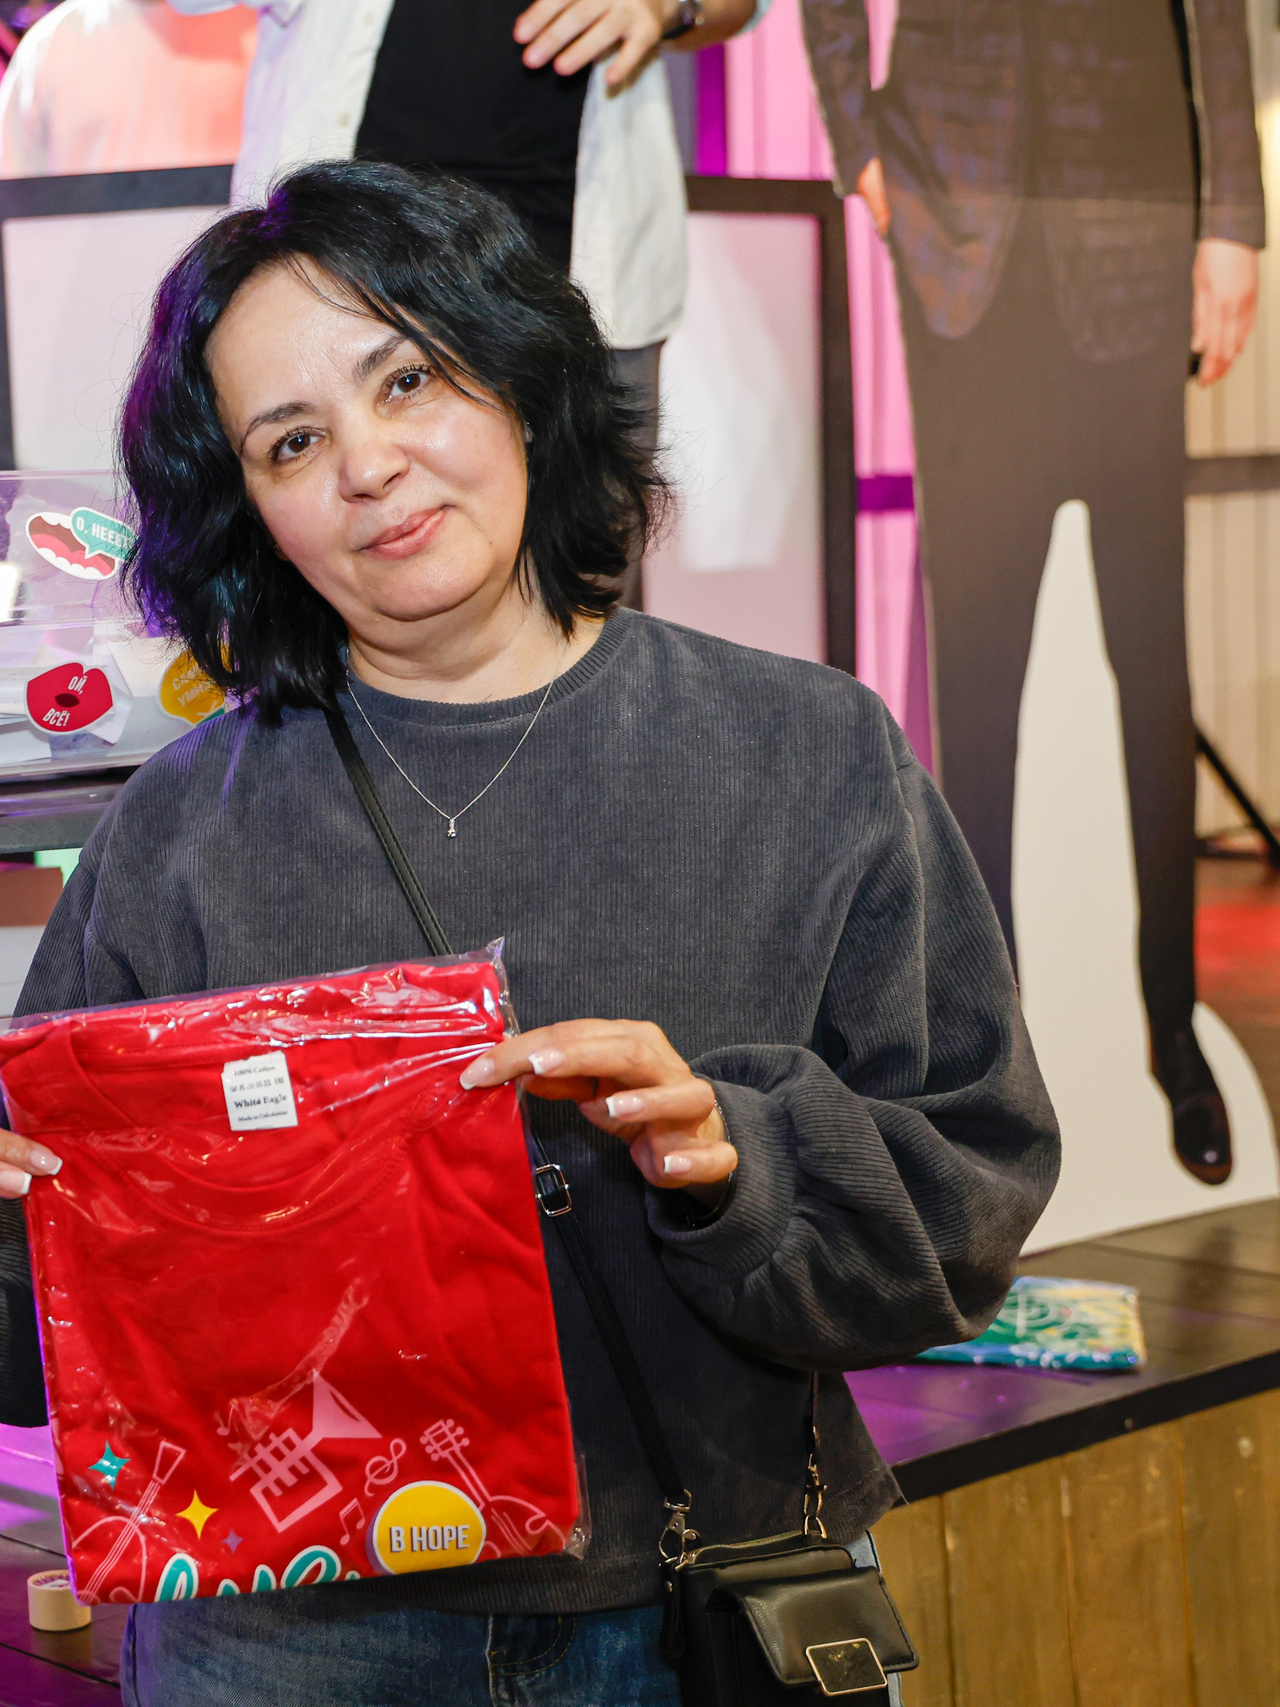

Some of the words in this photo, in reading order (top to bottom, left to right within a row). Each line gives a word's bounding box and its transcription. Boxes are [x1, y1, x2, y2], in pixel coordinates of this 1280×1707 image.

[67, 675, 88, 695] ОЙ,
[42, 708, 70, 727] ВСЁ!
[234, 1098, 261, 1108] White
[263, 1093, 287, 1104] Eagle
